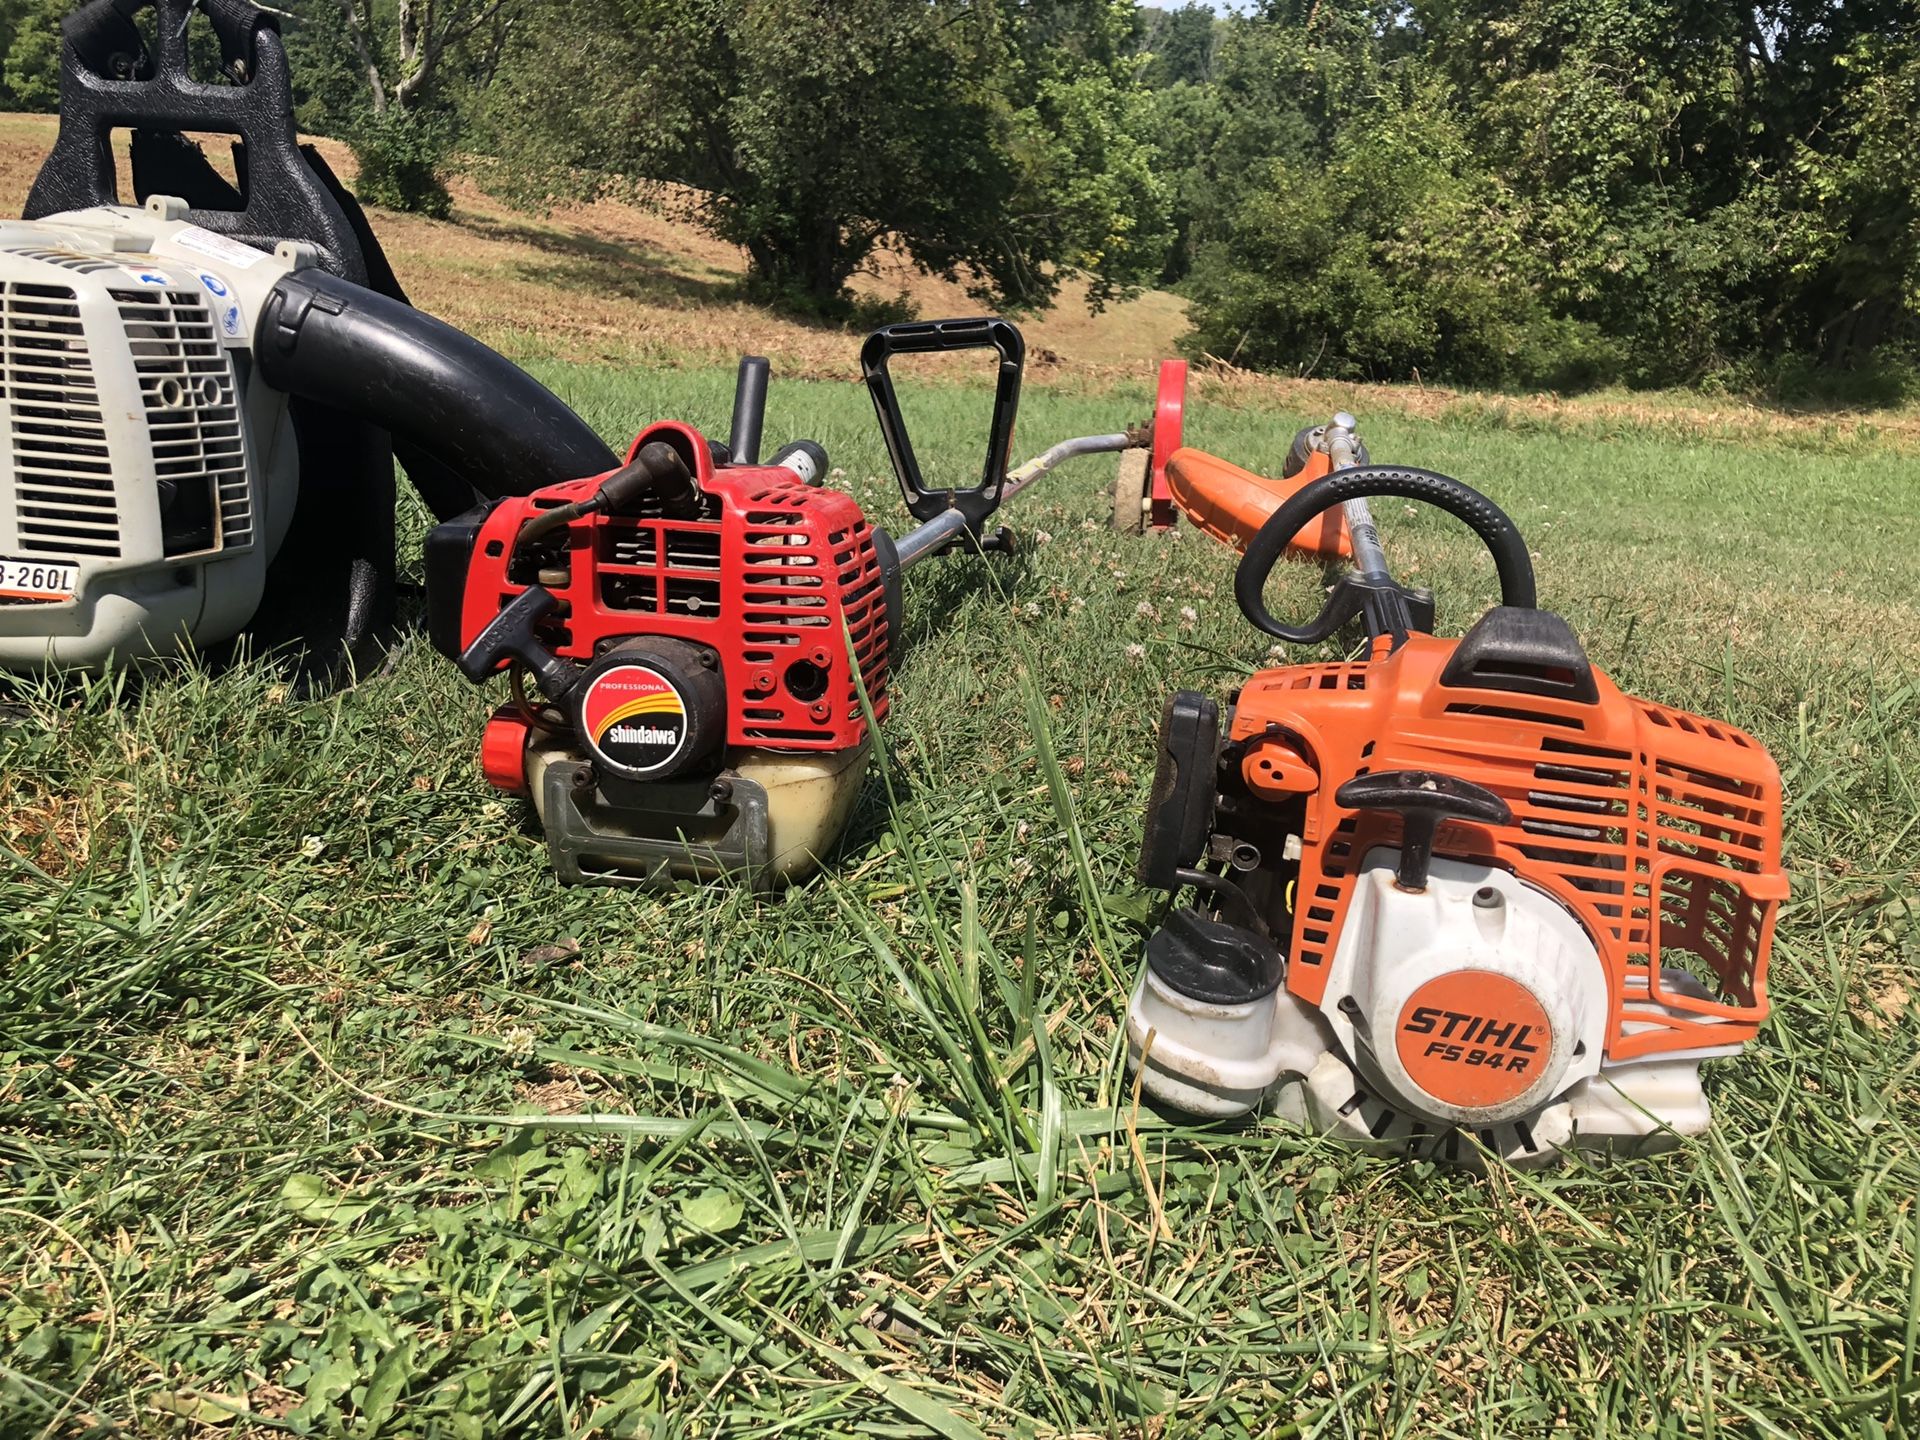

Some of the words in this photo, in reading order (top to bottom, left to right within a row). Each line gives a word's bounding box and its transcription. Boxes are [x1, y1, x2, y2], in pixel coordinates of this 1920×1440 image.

[600, 683, 666, 691] PROFESSIONAL
[610, 725, 676, 745] shindaiwa
[1404, 1007, 1539, 1053] STIHL
[1424, 1042, 1464, 1062] FS
[1465, 1049, 1504, 1069] 94
[1505, 1056, 1530, 1074] R
